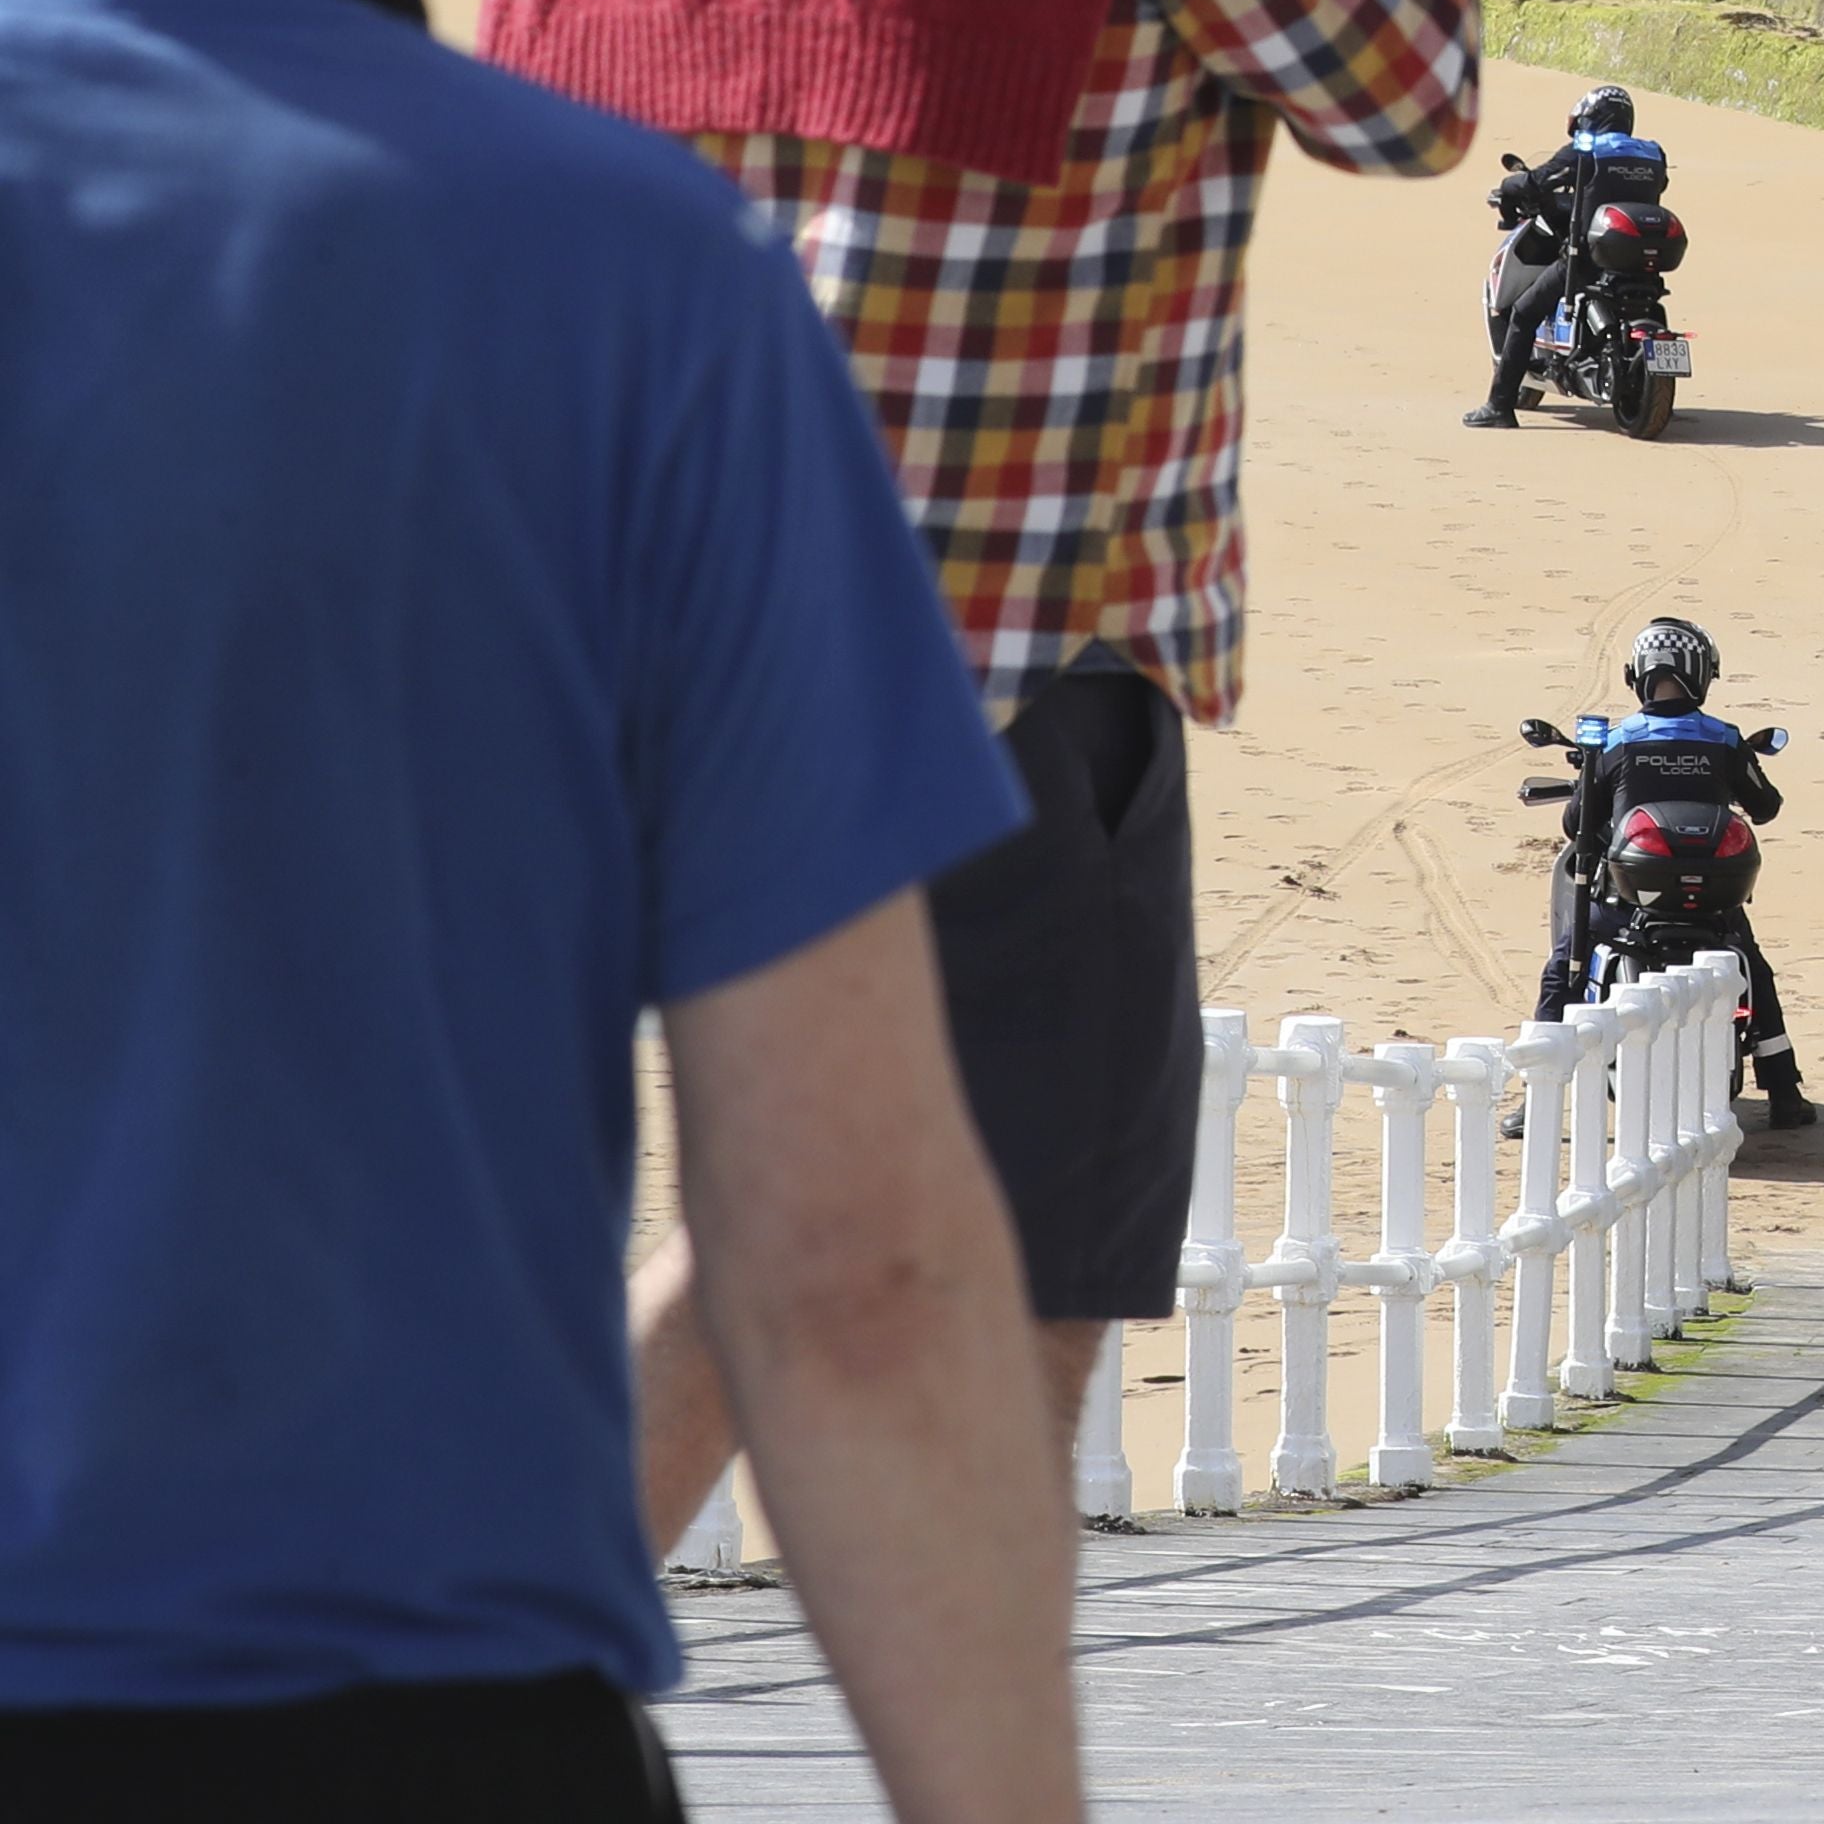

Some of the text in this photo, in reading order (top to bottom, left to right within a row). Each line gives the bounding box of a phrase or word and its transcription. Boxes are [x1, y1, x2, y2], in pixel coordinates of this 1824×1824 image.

[1655, 342, 1686, 357] 8833
[1656, 357, 1680, 370] LXY
[1635, 755, 1710, 766] POLICIA
[1660, 767, 1711, 775] LOCAL
